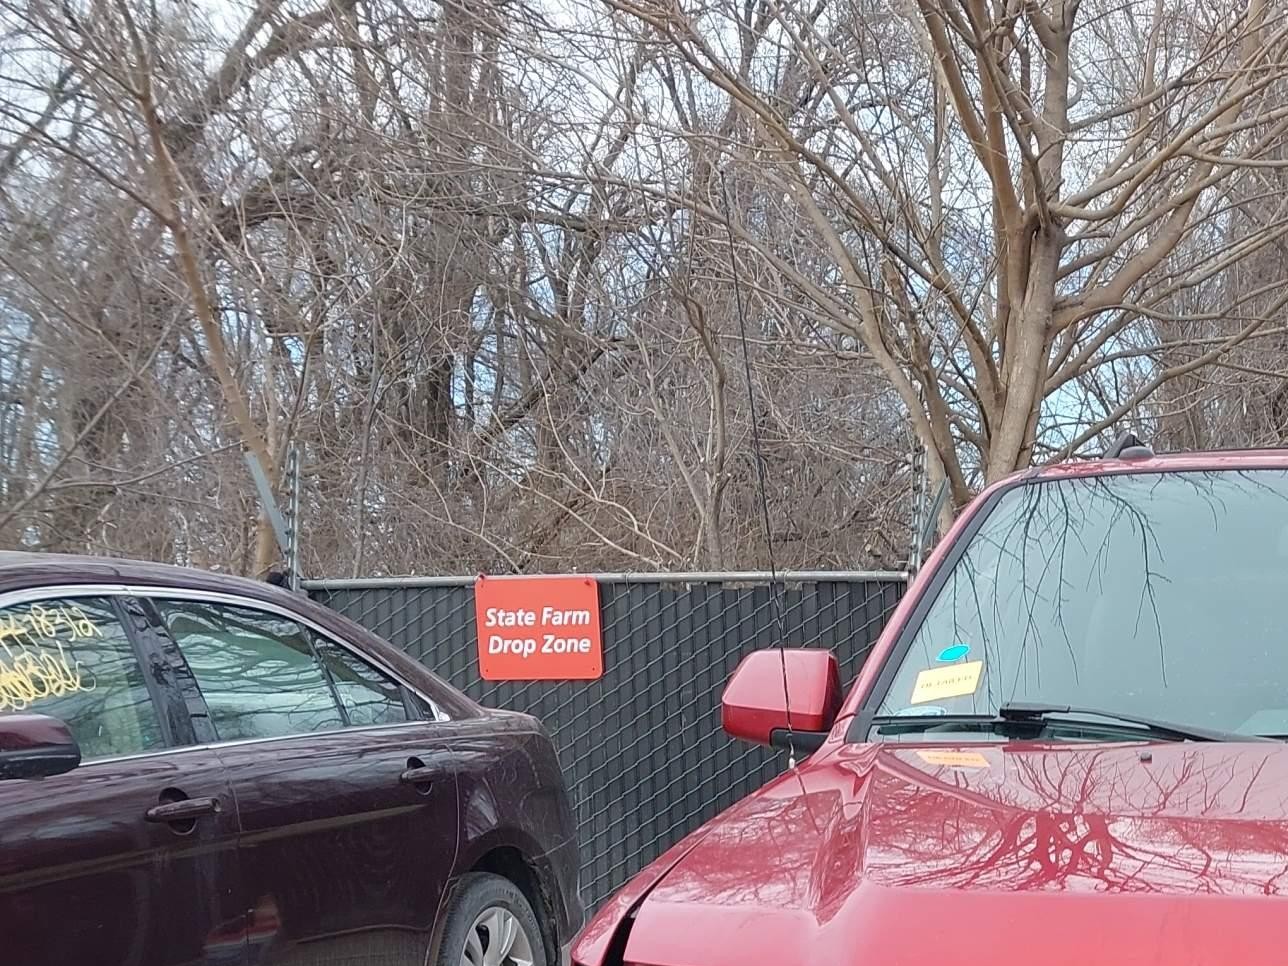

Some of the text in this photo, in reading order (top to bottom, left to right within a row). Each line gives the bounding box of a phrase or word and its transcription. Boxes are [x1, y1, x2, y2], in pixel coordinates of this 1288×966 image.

[485, 606, 590, 627] State Farm
[488, 635, 591, 658] Drop Zone
